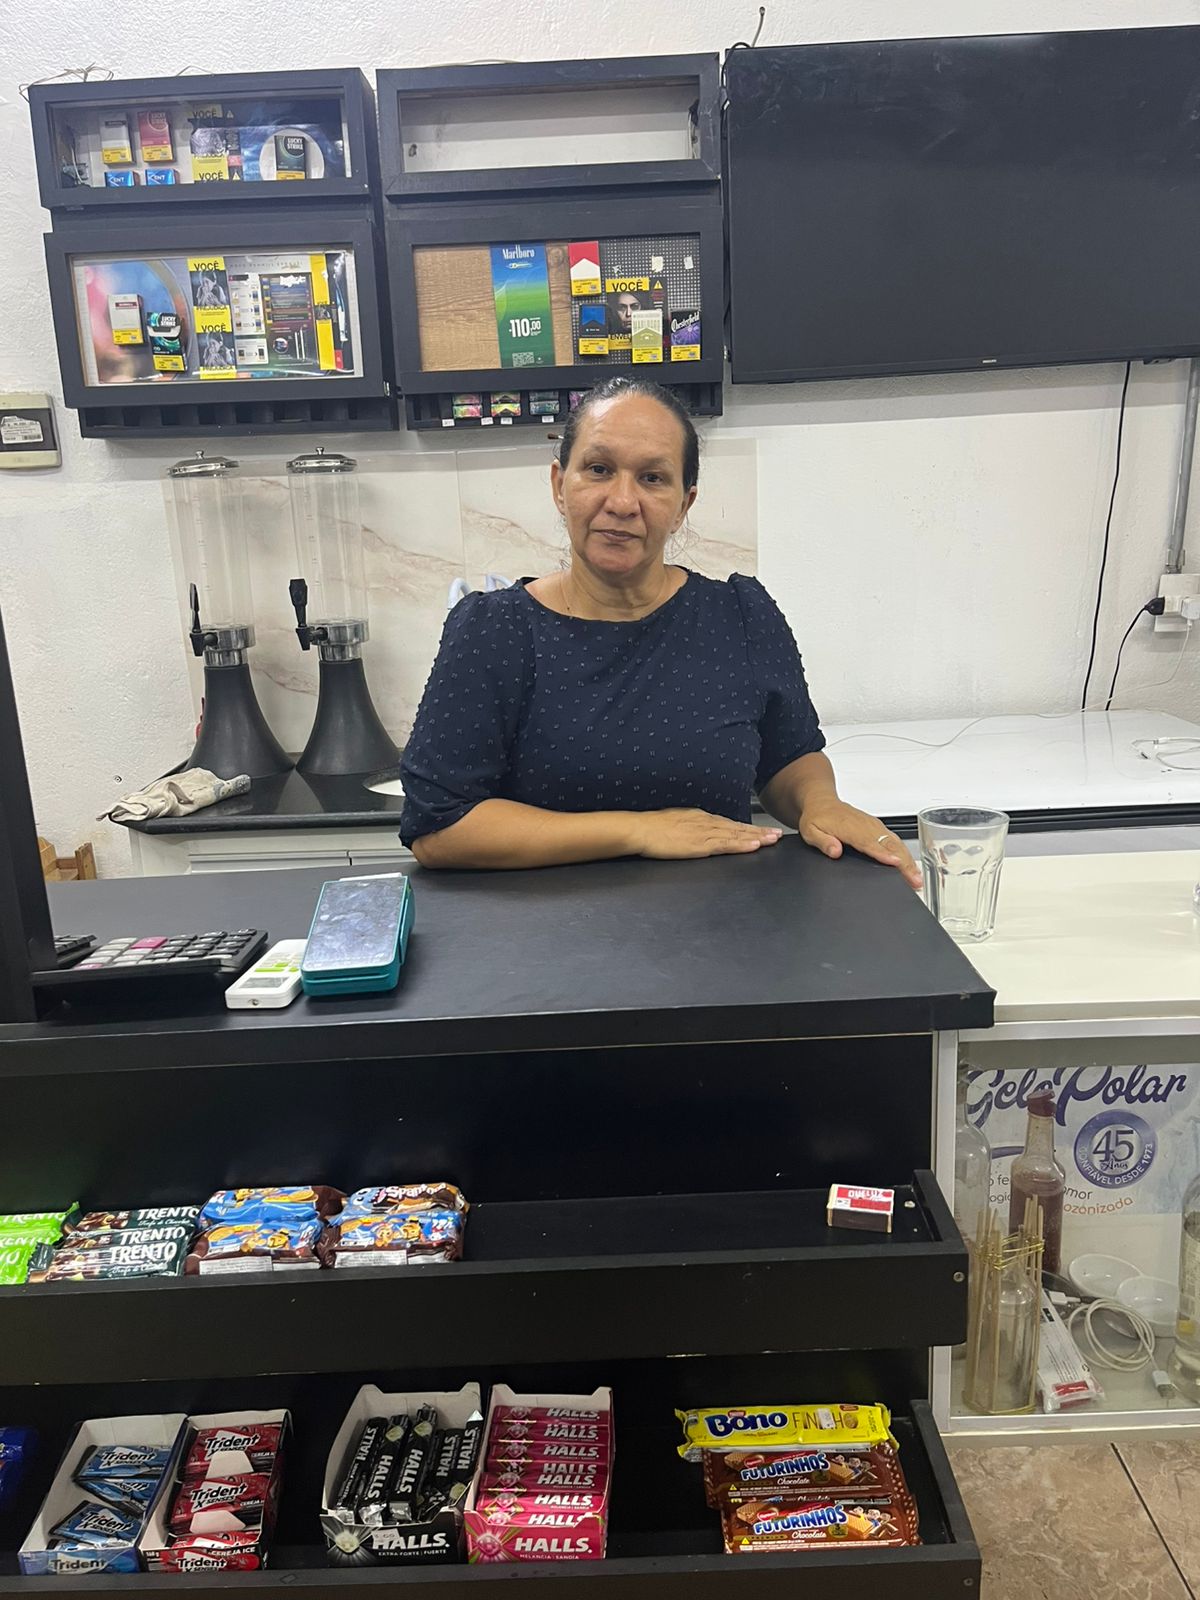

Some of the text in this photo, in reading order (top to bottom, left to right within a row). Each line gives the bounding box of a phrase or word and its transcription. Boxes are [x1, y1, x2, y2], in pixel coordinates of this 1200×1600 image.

[502, 245, 535, 260] Marlboro
[194, 260, 220, 271] VOCÊ
[611, 278, 644, 292] VOCÊ
[201, 323, 227, 332] VOCÊ
[1053, 1065, 1187, 1126] Polar
[1092, 1130, 1134, 1162] 45
[1114, 1166, 1145, 1185] DESDE
[1141, 1143, 1153, 1164] 1973
[848, 1188, 884, 1199] QUELUZ
[1063, 1196, 1134, 1215] ozonizada
[137, 1206, 200, 1221] TRENTO
[120, 1226, 187, 1245] TRENTO
[109, 1241, 178, 1264] TRENTO
[704, 1412, 788, 1437] Bono
[205, 1434, 260, 1449] Trident
[103, 1451, 157, 1460] Trident
[741, 1453, 831, 1481] FUTURINHOS
[777, 1477, 811, 1485] Chocolate
[191, 1483, 248, 1501] Trident
[86, 1511, 133, 1531] Trident
[753, 1504, 849, 1535] FUTURINHOS
[791, 1529, 827, 1539] Chocolate
[211, 1549, 241, 1557] CEREJA
[242, 1546, 256, 1554] ICE
[49, 1558, 107, 1570] Trident
[177, 1556, 228, 1568] Trident
